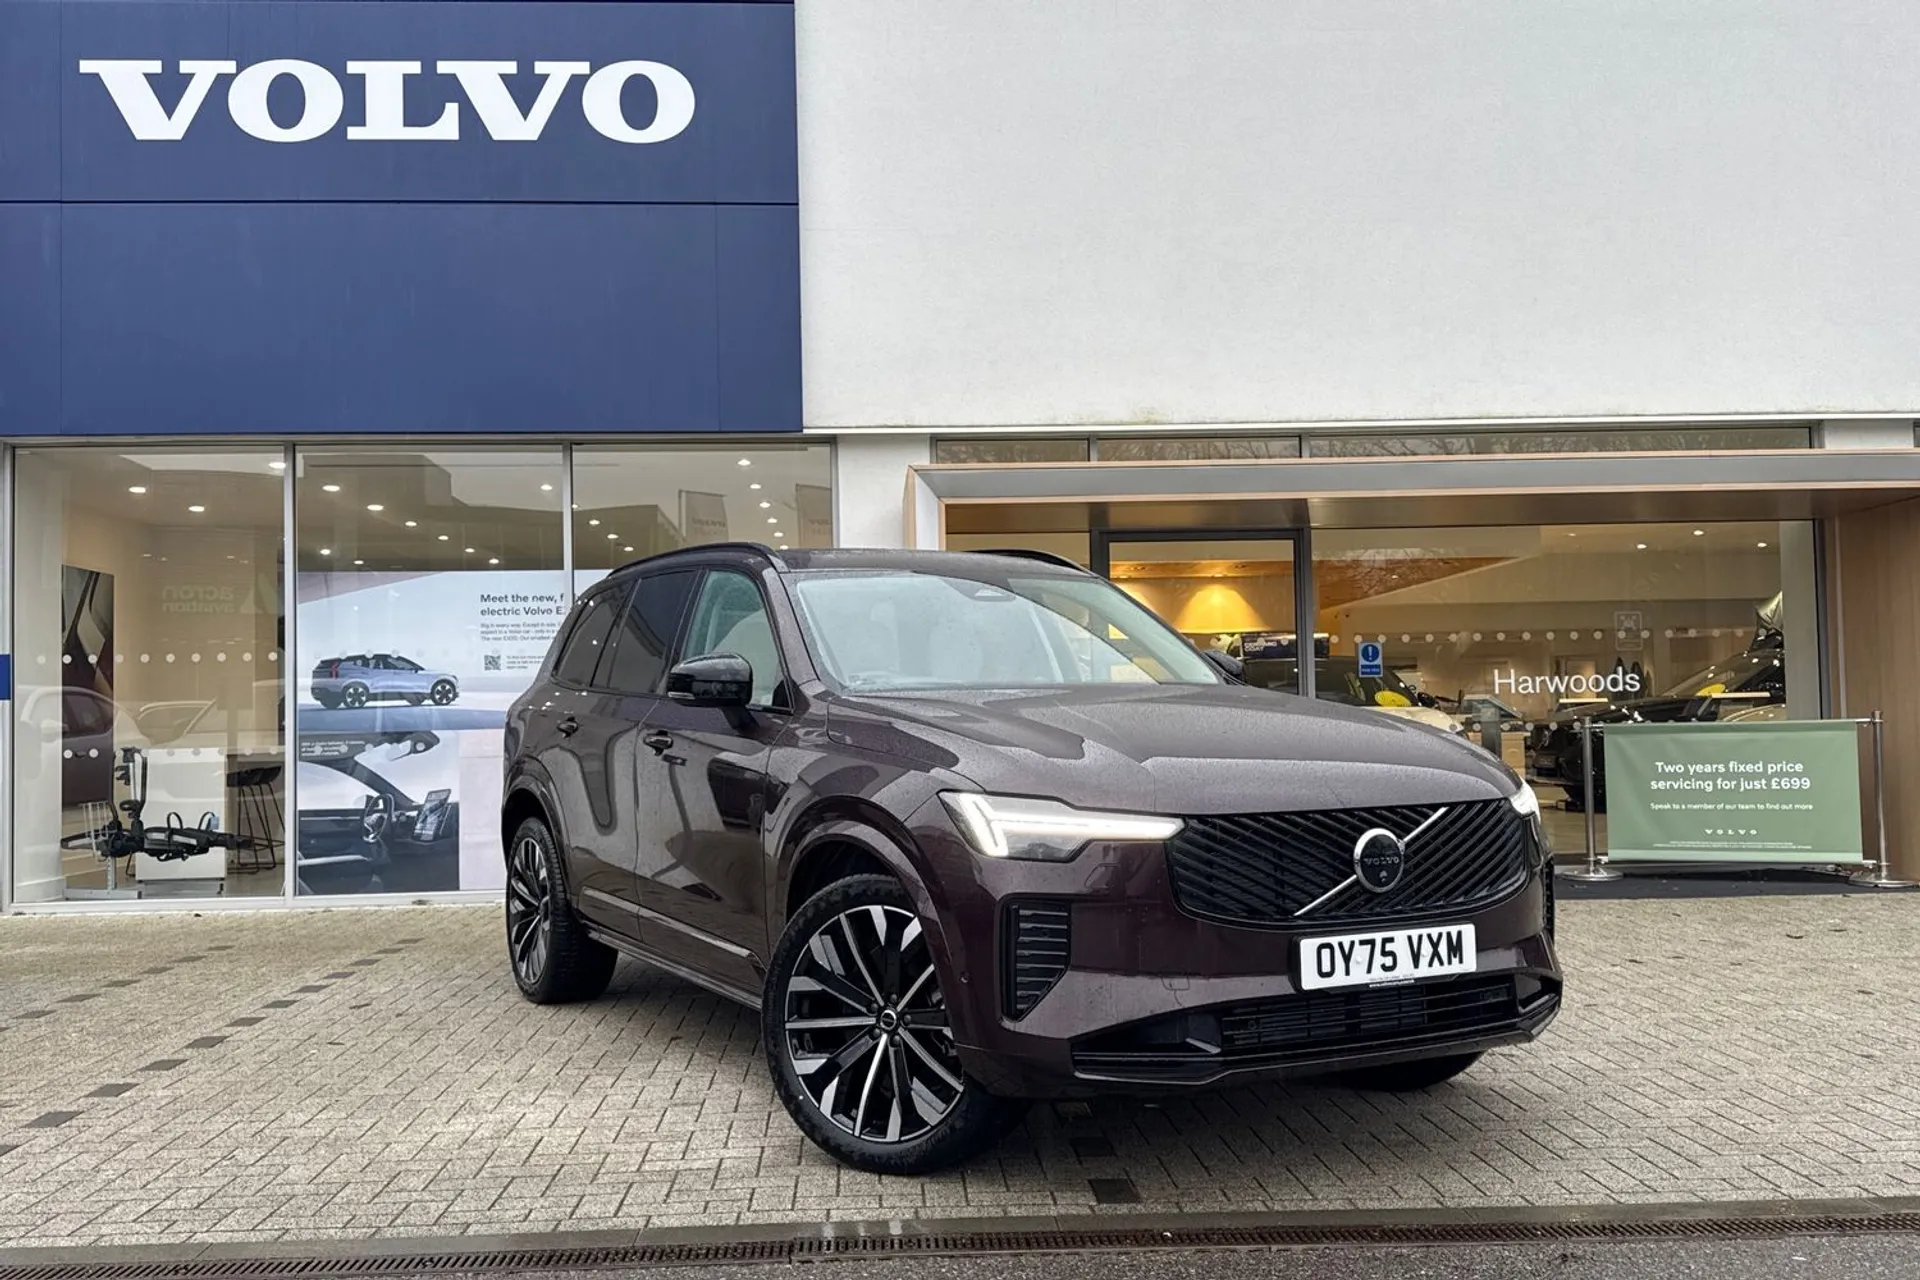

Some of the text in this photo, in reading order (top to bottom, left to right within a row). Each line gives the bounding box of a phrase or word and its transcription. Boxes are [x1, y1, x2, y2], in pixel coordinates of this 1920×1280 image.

[79, 58, 695, 144] VOLVO
[480, 594, 508, 603] Meet
[511, 593, 529, 602] the
[532, 594, 557, 604] new,
[480, 606, 520, 616] electric
[523, 606, 553, 615] Volvo
[1493, 665, 1641, 694] Harwoods
[1655, 760, 1804, 775] Two years fixed price
[1650, 777, 1811, 792] servicing for just £699
[1650, 802, 1672, 811] Speak
[1687, 802, 1715, 810] member
[1716, 802, 1724, 810] of
[1765, 802, 1780, 810] find
[1316, 930, 1464, 979] OY75 VXM
